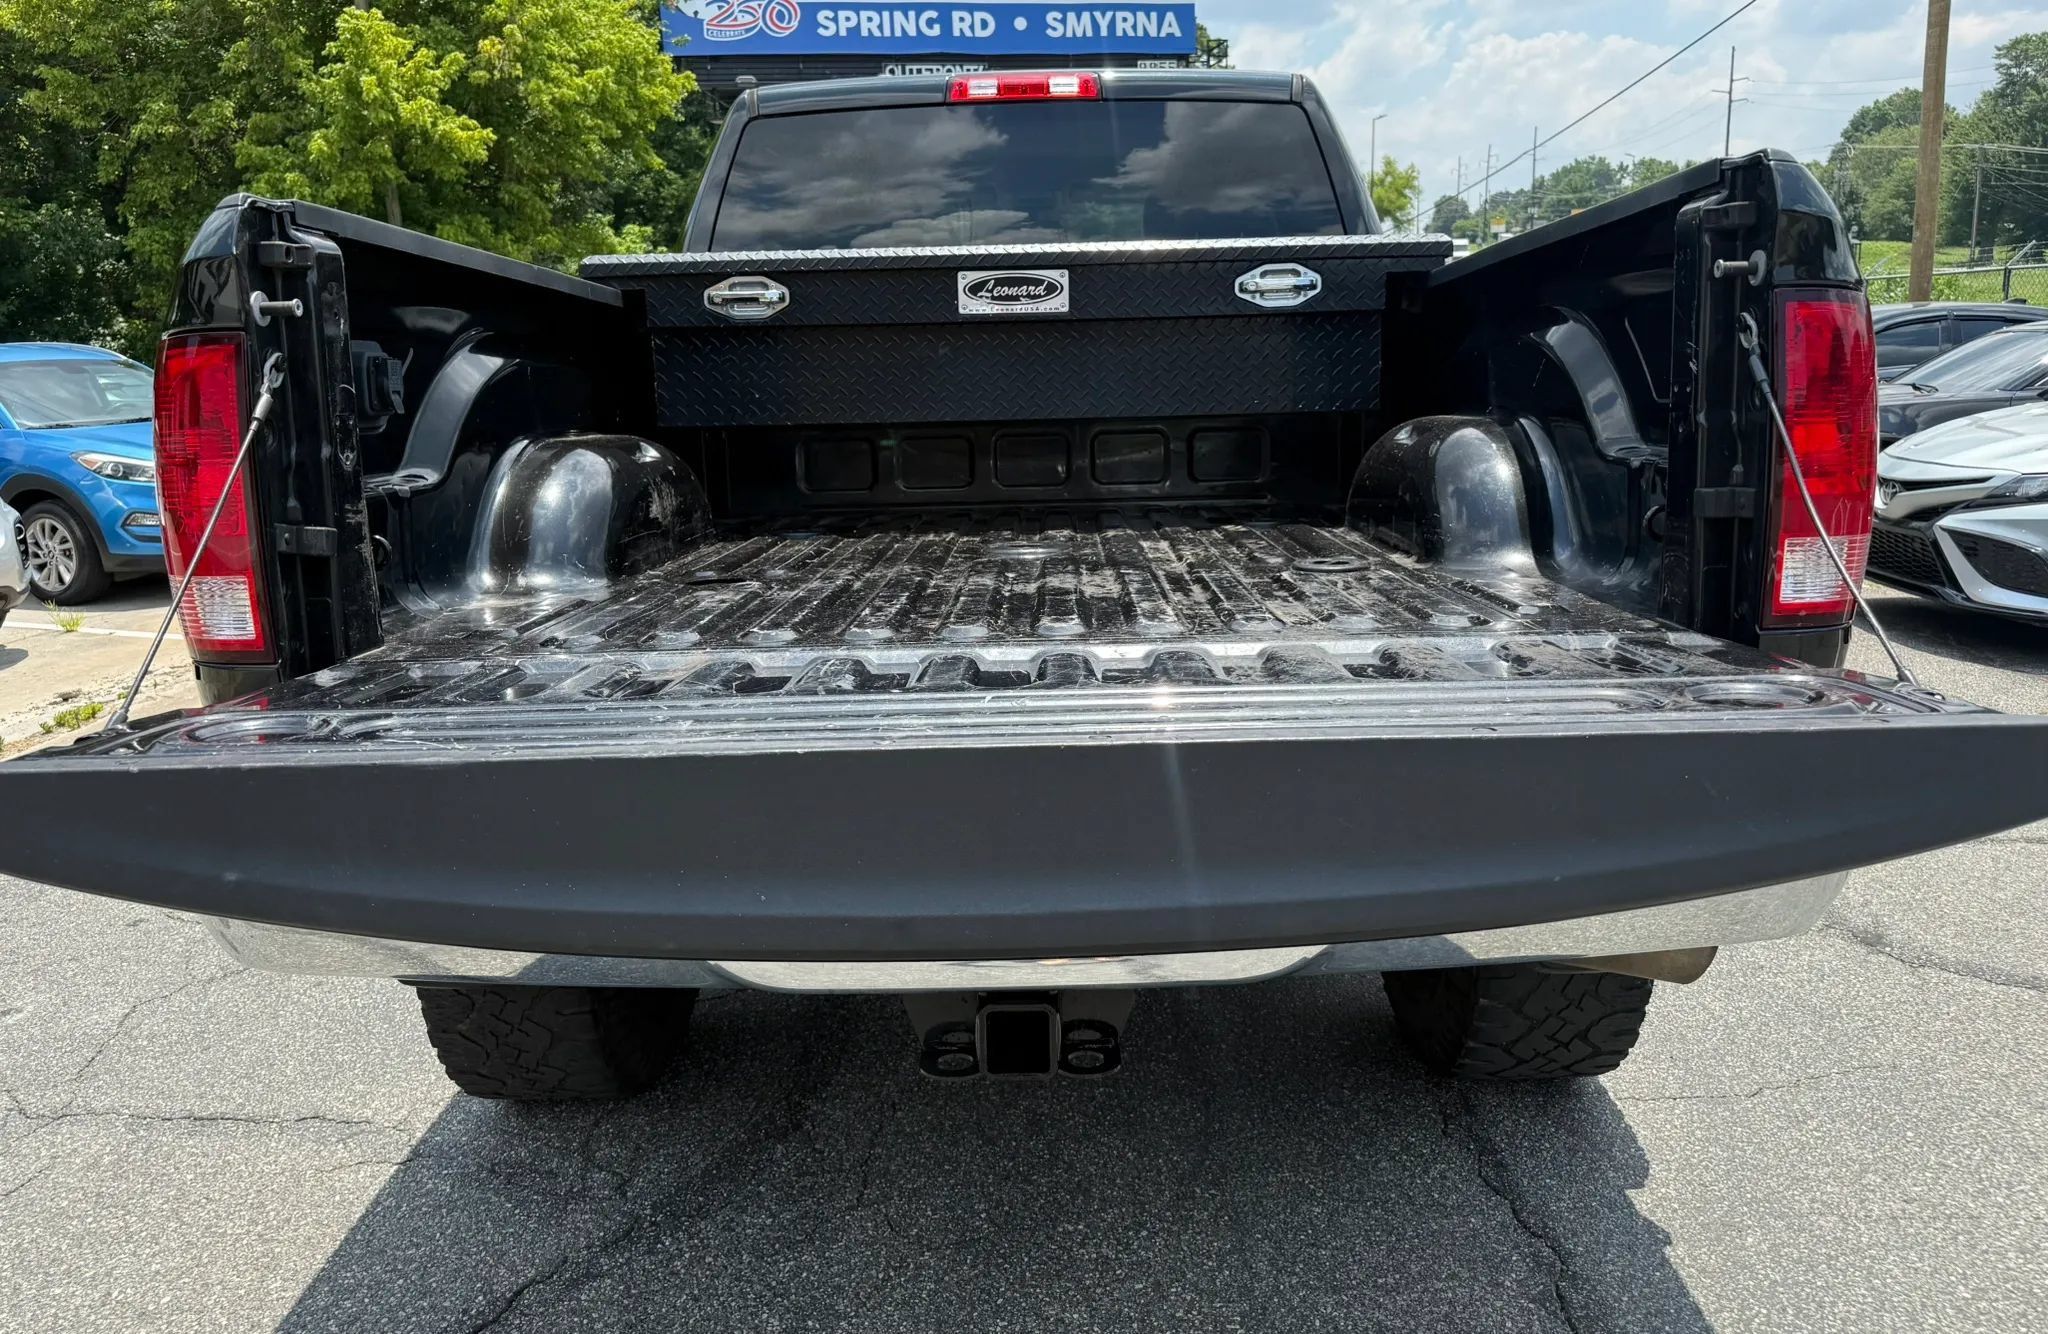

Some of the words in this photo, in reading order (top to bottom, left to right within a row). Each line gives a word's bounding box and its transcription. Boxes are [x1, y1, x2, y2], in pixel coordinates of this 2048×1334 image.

[816, 10, 941, 37] SPRING
[952, 11, 996, 37] RD
[1046, 11, 1182, 38] SMYRNA
[977, 280, 1048, 296] Leonard
